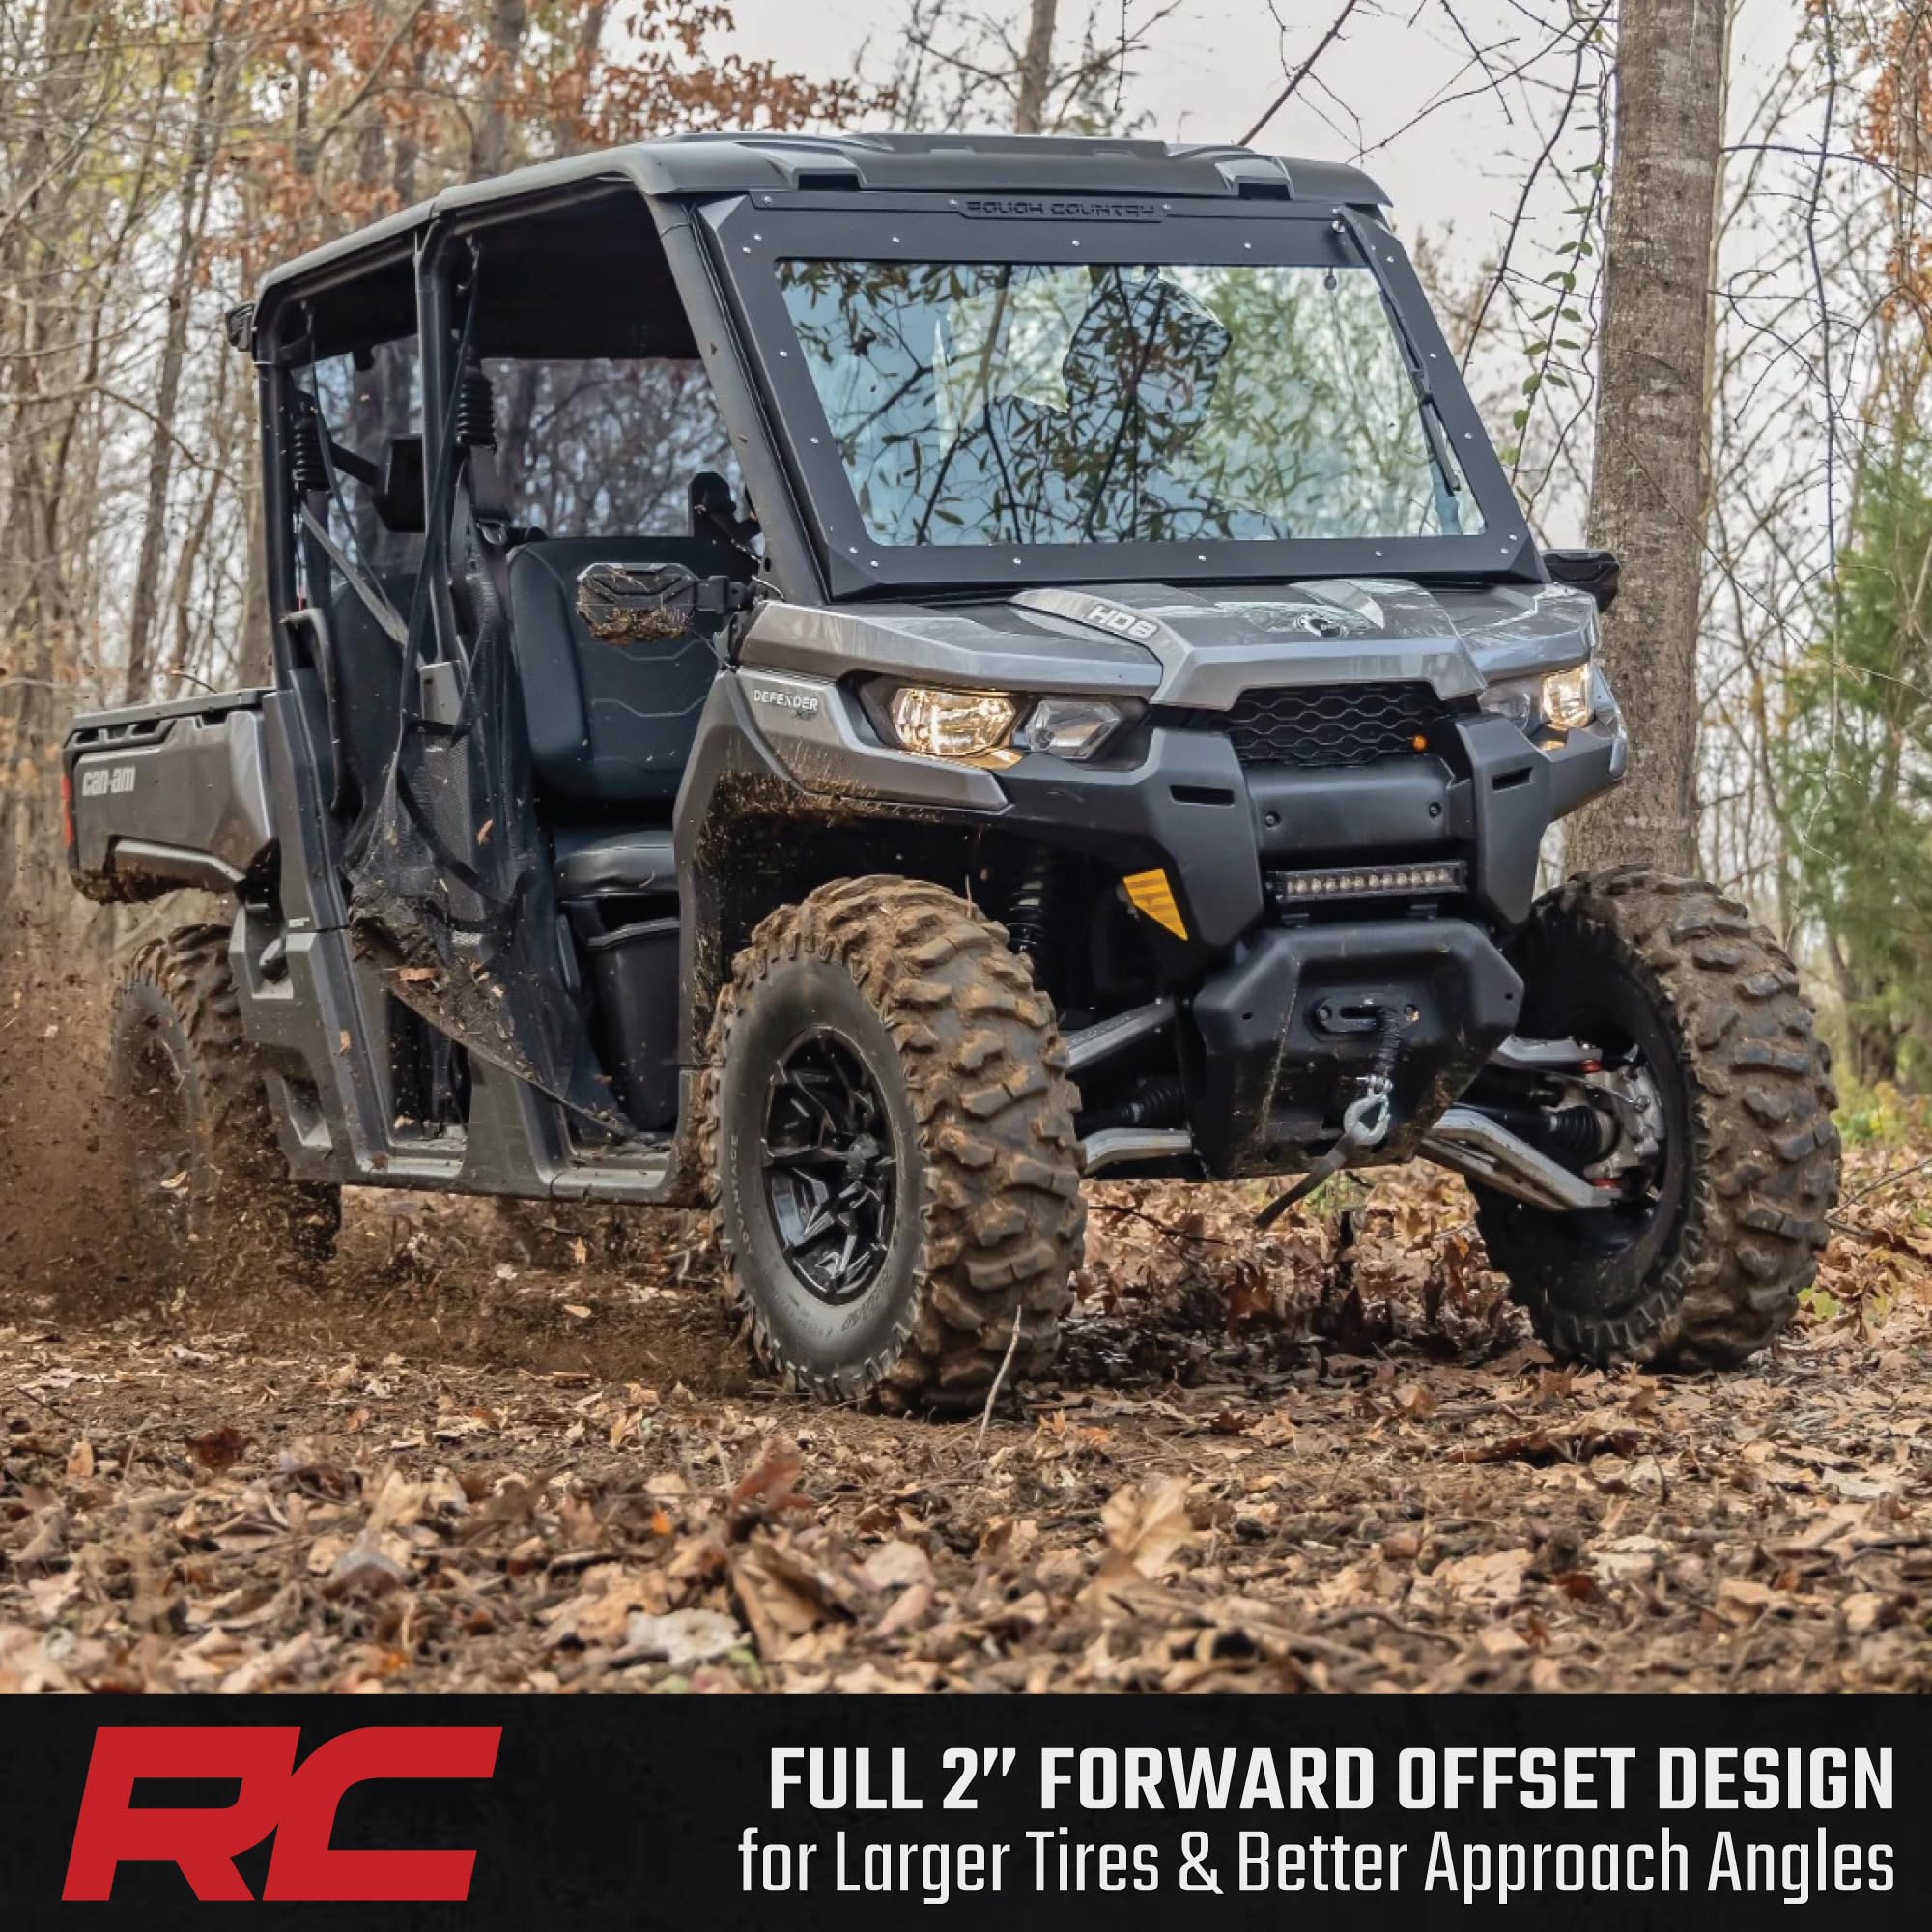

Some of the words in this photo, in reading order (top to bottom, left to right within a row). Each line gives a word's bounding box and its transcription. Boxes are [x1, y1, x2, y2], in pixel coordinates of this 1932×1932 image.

[965, 200, 1044, 214] ROUGH
[1050, 202, 1154, 217] COUNTRY
[753, 689, 819, 712] DEFENDER
